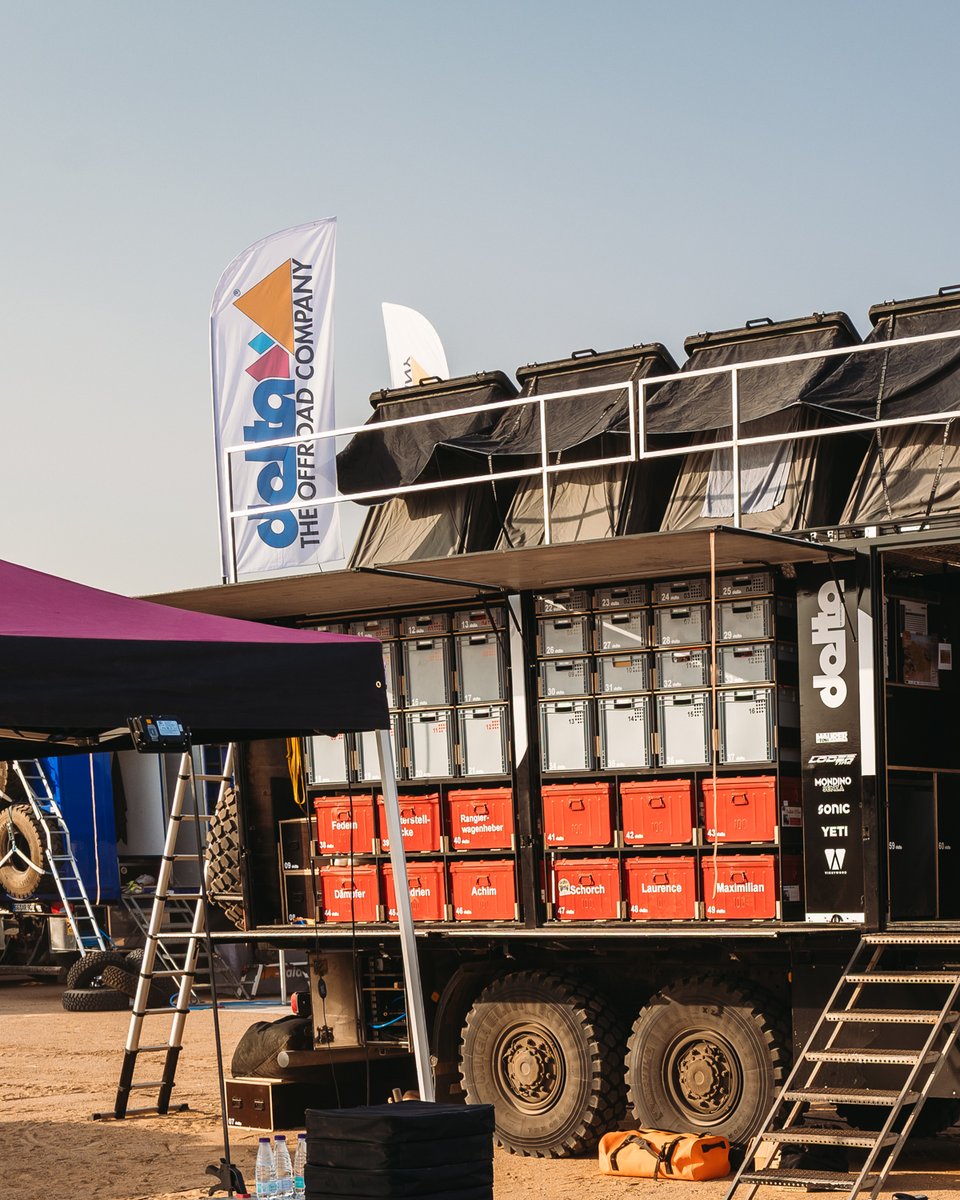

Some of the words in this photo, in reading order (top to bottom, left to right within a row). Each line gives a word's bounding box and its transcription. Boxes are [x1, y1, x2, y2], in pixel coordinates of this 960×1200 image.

[292, 258, 314, 380] COMPANY
[296, 388, 316, 500] OFFROAD
[298, 508, 320, 548] THE
[662, 593, 670, 601] 24
[814, 777, 852, 786] MONDINO
[400, 816, 430, 824] terstell-
[460, 814, 490, 823] Rangier-
[401, 829, 413, 837] cke
[462, 824, 503, 835] wagenheber
[708, 829, 716, 837] 43
[821, 826, 848, 837] YETI
[547, 833, 555, 841] 41
[410, 888, 430, 897] drien
[472, 886, 497, 896] Achim
[570, 884, 605, 895] Schorch
[642, 883, 682, 893] Laurence
[717, 882, 764, 893] Maximilian
